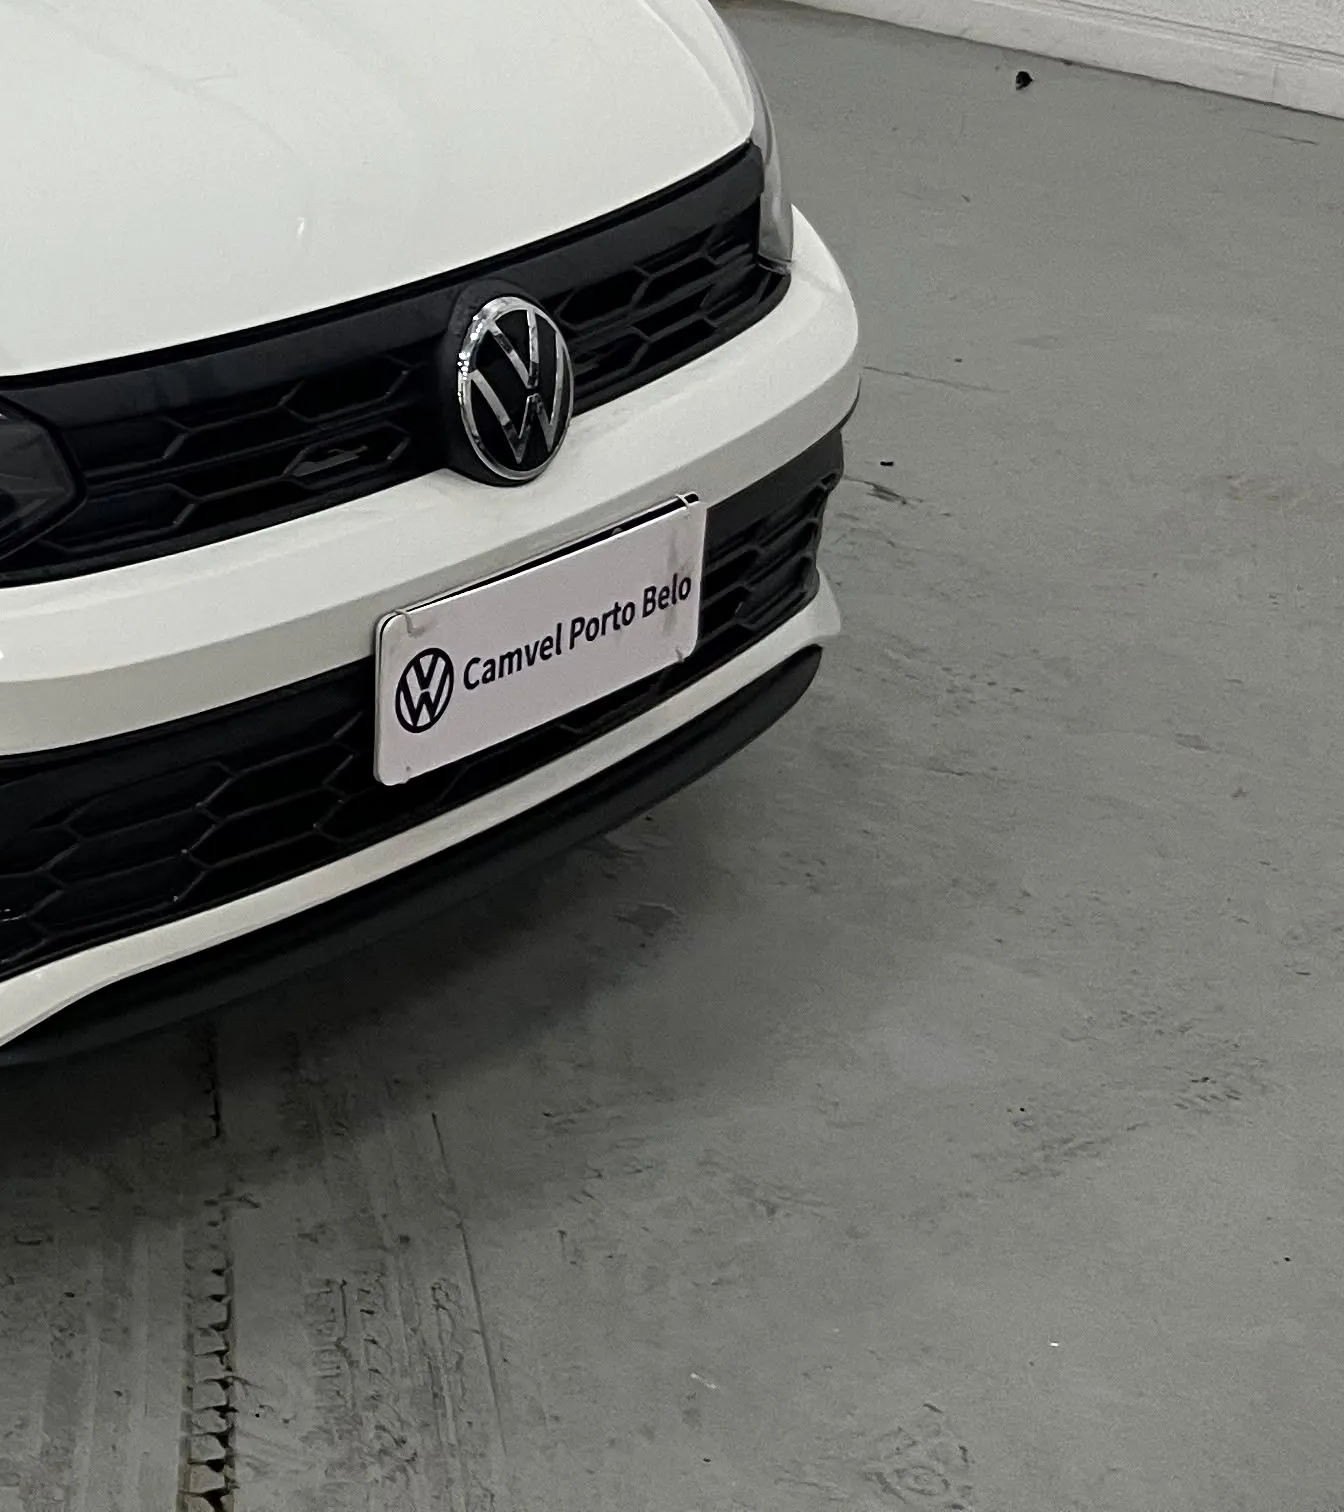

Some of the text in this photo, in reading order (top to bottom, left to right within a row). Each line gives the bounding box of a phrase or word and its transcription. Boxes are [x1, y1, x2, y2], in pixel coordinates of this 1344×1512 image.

[462, 623, 562, 691] Camvel
[568, 605, 636, 651] Porto
[642, 572, 692, 620] Belo
